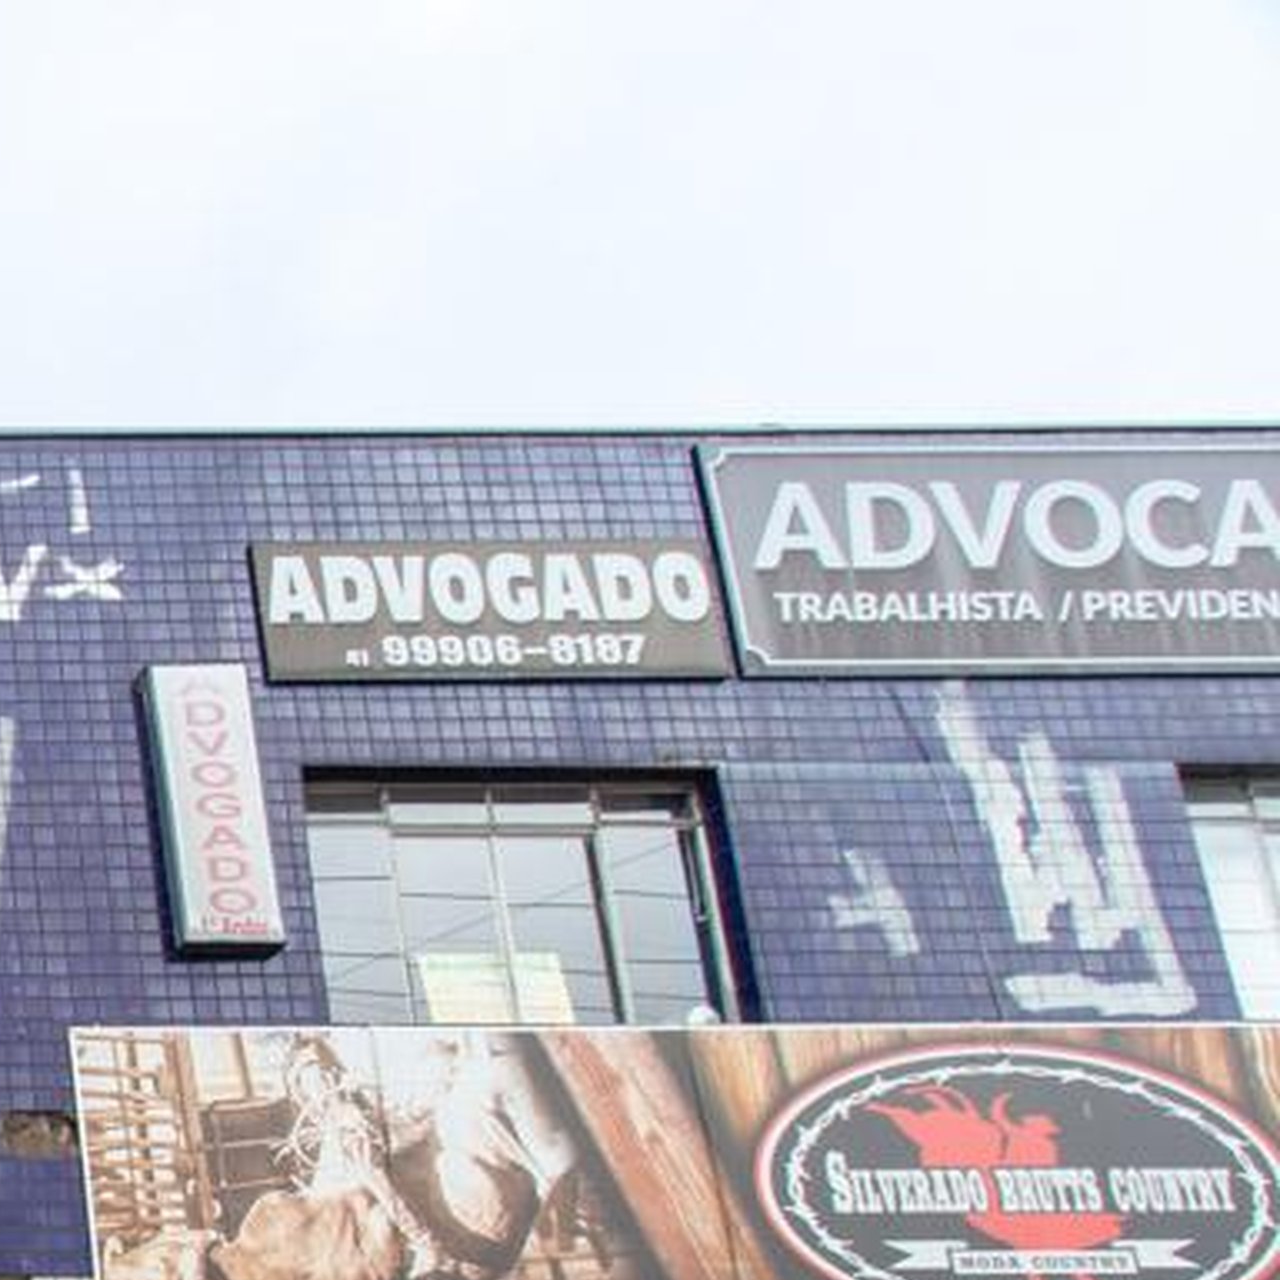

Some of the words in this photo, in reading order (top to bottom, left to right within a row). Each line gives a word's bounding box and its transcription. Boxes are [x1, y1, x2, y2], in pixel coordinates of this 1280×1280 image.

[754, 479, 1280, 570] ADVOCA
[269, 551, 711, 625] ADVOGADO
[774, 590, 1043, 623] TRABALHISTA
[346, 649, 369, 667] 41
[382, 633, 646, 667] 99906-8187
[1107, 1166, 1237, 1213] COUNTRY
